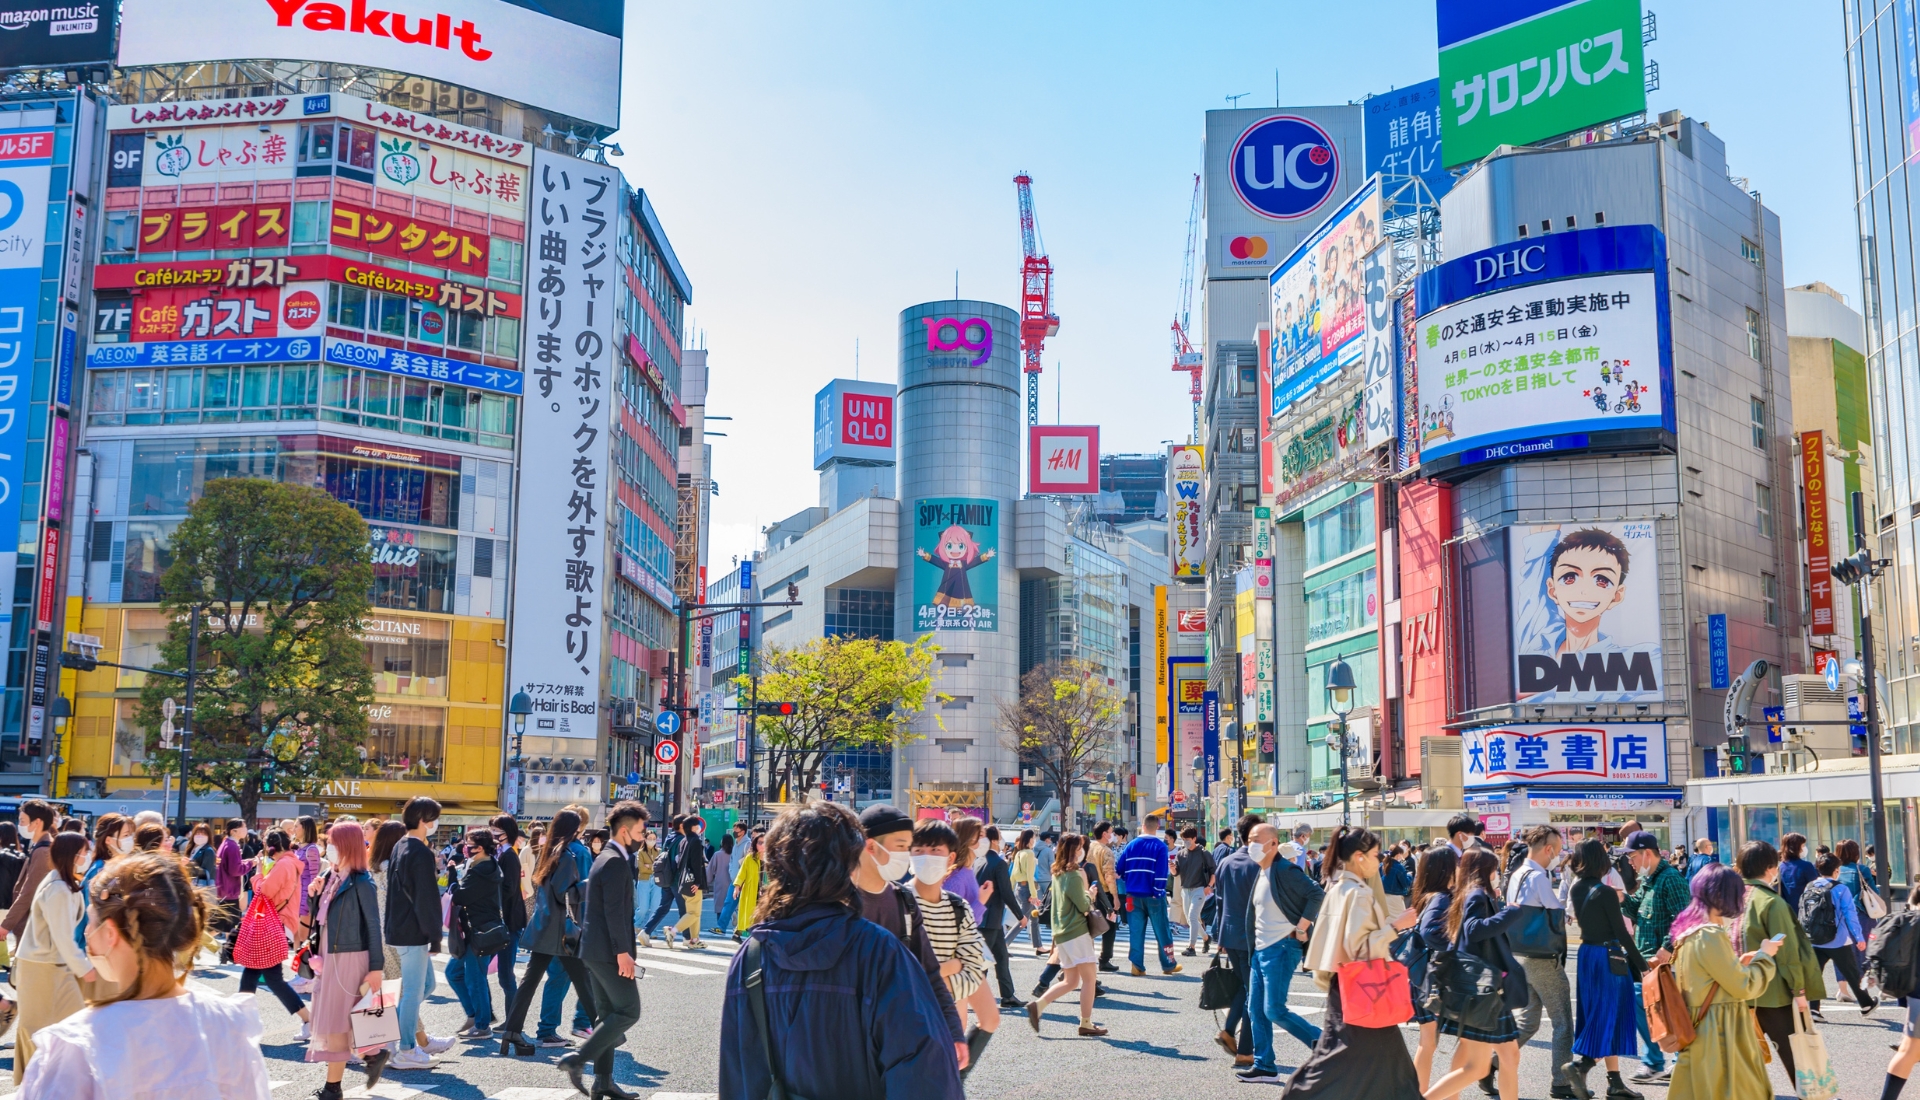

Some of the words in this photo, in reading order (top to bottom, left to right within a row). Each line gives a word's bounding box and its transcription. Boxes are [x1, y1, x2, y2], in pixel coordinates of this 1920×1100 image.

[1, 9, 48, 24] mazon
[51, 3, 99, 20] music
[56, 22, 92, 32] UNLIMITED
[266, 0, 493, 61] Yakult
[1452, 28, 1629, 127] サロンパス
[131, 98, 289, 124] しゃぶしゃぶバイキング
[306, 98, 327, 111] 寿司
[366, 102, 524, 158] しゃぶしゃぶバイキング
[113, 150, 141, 169] 9F
[197, 134, 287, 167] しゃぶ葉
[1243, 142, 1329, 190] UC
[428, 154, 520, 203] しゃぶ葉
[143, 208, 285, 243] プライス
[333, 208, 483, 264] コンタクト
[0, 236, 33, 256] city
[70, 227, 82, 289] 献血ルーム
[134, 268, 222, 287] Caféレストラン
[226, 257, 299, 288] ガスト
[1474, 244, 1546, 284] DHC
[345, 267, 434, 299] Caféレストラン
[439, 282, 507, 318] ガスト
[533, 164, 570, 413] いい曲あります。
[99, 308, 131, 330] 7F
[139, 305, 178, 323] Café
[139, 323, 176, 334] レストラン
[181, 298, 270, 337] ガスト
[288, 308, 317, 319] ガスト
[1425, 290, 1630, 349] 春の交通安全運動実施中
[95, 347, 136, 363] AEON
[151, 343, 280, 363] 英会話イーオン
[290, 342, 309, 356] 6F
[922, 318, 993, 367] 109
[1364, 250, 1391, 436] もんじゃ
[334, 343, 378, 365] AEON
[391, 352, 519, 389] 英会話イーオン
[1445, 346, 1600, 388] 世界一の交通安全都市
[1461, 370, 1576, 402] TOKYOを目指して
[565, 175, 611, 675] ブラジャーのホックを外す歌より、
[820, 394, 830, 426] THE
[849, 400, 883, 420] UNI
[848, 421, 886, 441] QLO
[1048, 448, 1082, 471] H&M
[1485, 445, 1509, 459] DHC
[1510, 439, 1554, 456] Channel
[52, 432, 65, 504] 品川美容外科
[1805, 436, 1824, 547] クスリのことなら
[50, 507, 59, 517] 4F
[920, 503, 993, 527] SPY×FAMILY
[1810, 556, 1833, 625] 三千里
[40, 620, 50, 630] 7F
[364, 634, 406, 644] PROVENCE
[919, 619, 961, 627] テレビ東京系
[961, 619, 976, 628] ON
[978, 620, 992, 628] AIR
[702, 636, 710, 667] 調剤薬局
[1713, 618, 1725, 685] 大盛堂商事ビル
[1518, 652, 1657, 693] DMM
[526, 683, 585, 696] サブスク解禁
[1185, 681, 1206, 700] 薬
[535, 698, 559, 713] Hair
[561, 700, 570, 713] is
[571, 700, 596, 714] Bad
[704, 693, 712, 724] 渋谷駅前
[540, 720, 553, 728] EMI
[1207, 754, 1215, 786] みずほ銀
[1469, 734, 1647, 774] 大盛堂書店
